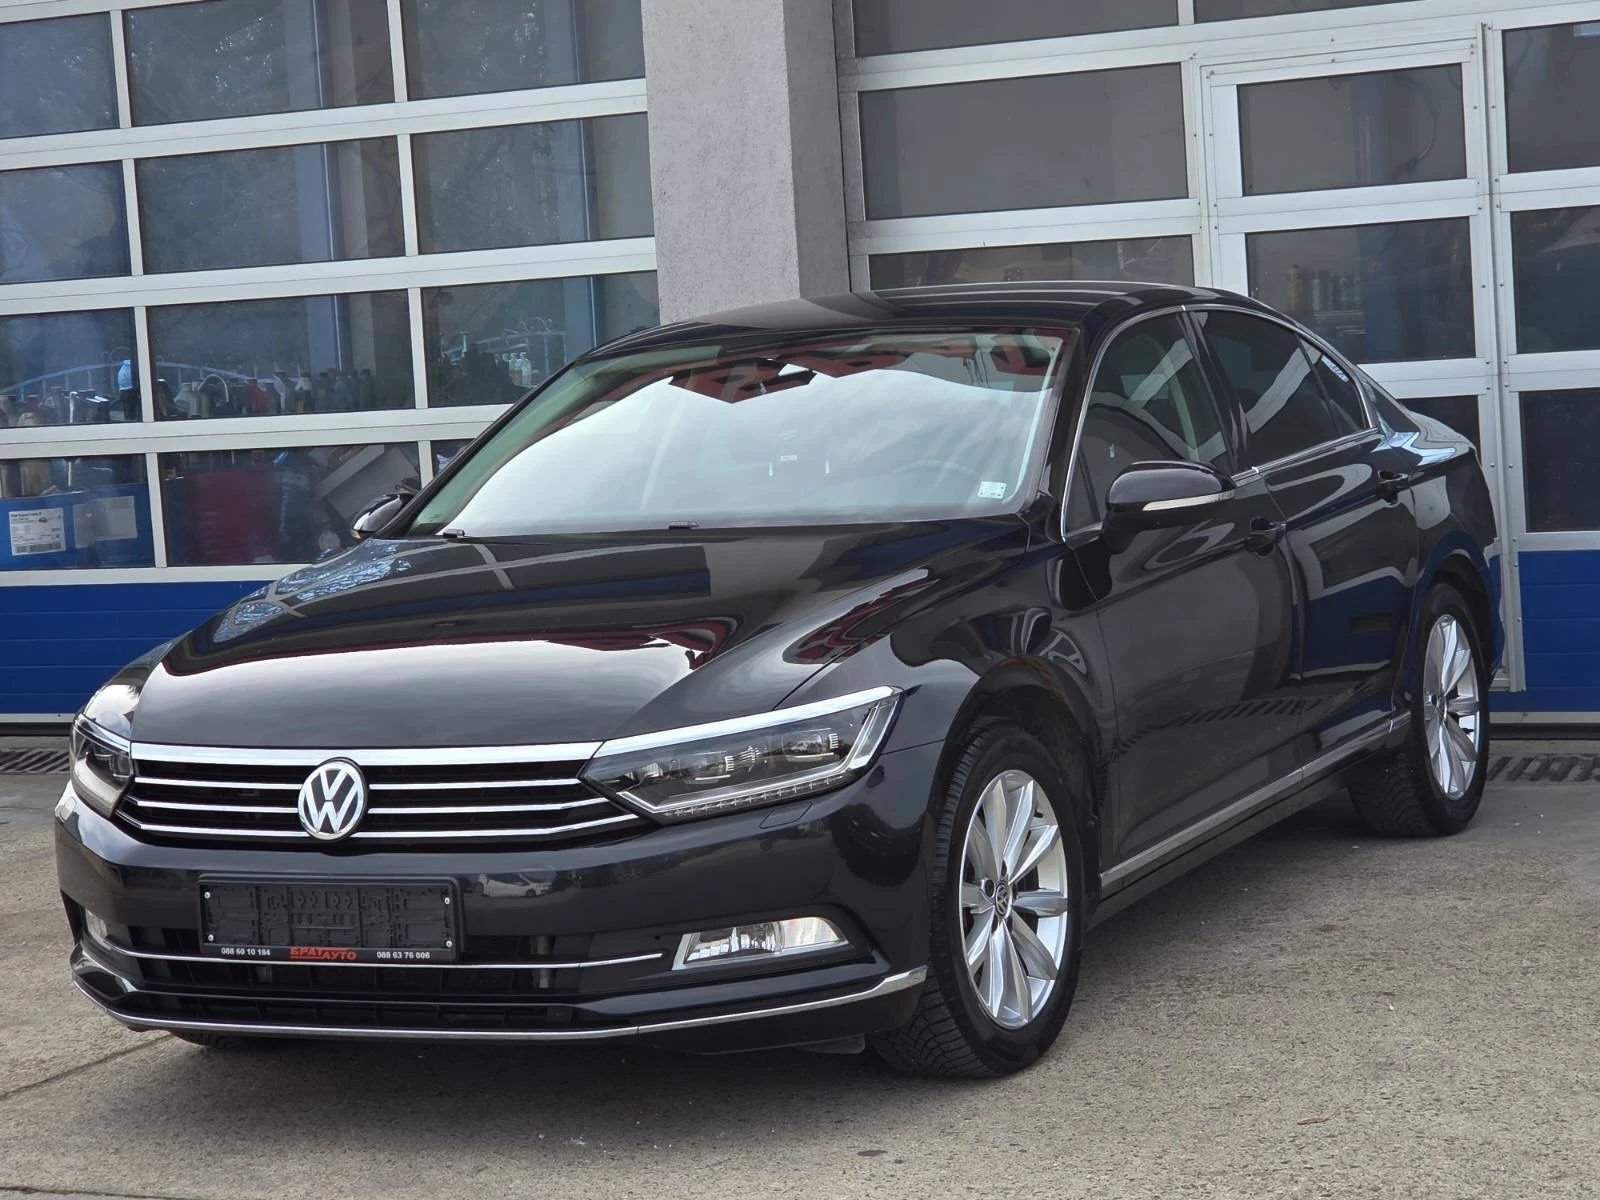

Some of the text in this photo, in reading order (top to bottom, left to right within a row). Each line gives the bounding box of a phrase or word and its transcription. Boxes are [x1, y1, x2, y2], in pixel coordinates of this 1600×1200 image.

[299, 762, 363, 838] VW
[247, 948, 256, 956] 10
[376, 951, 391, 959] 088
